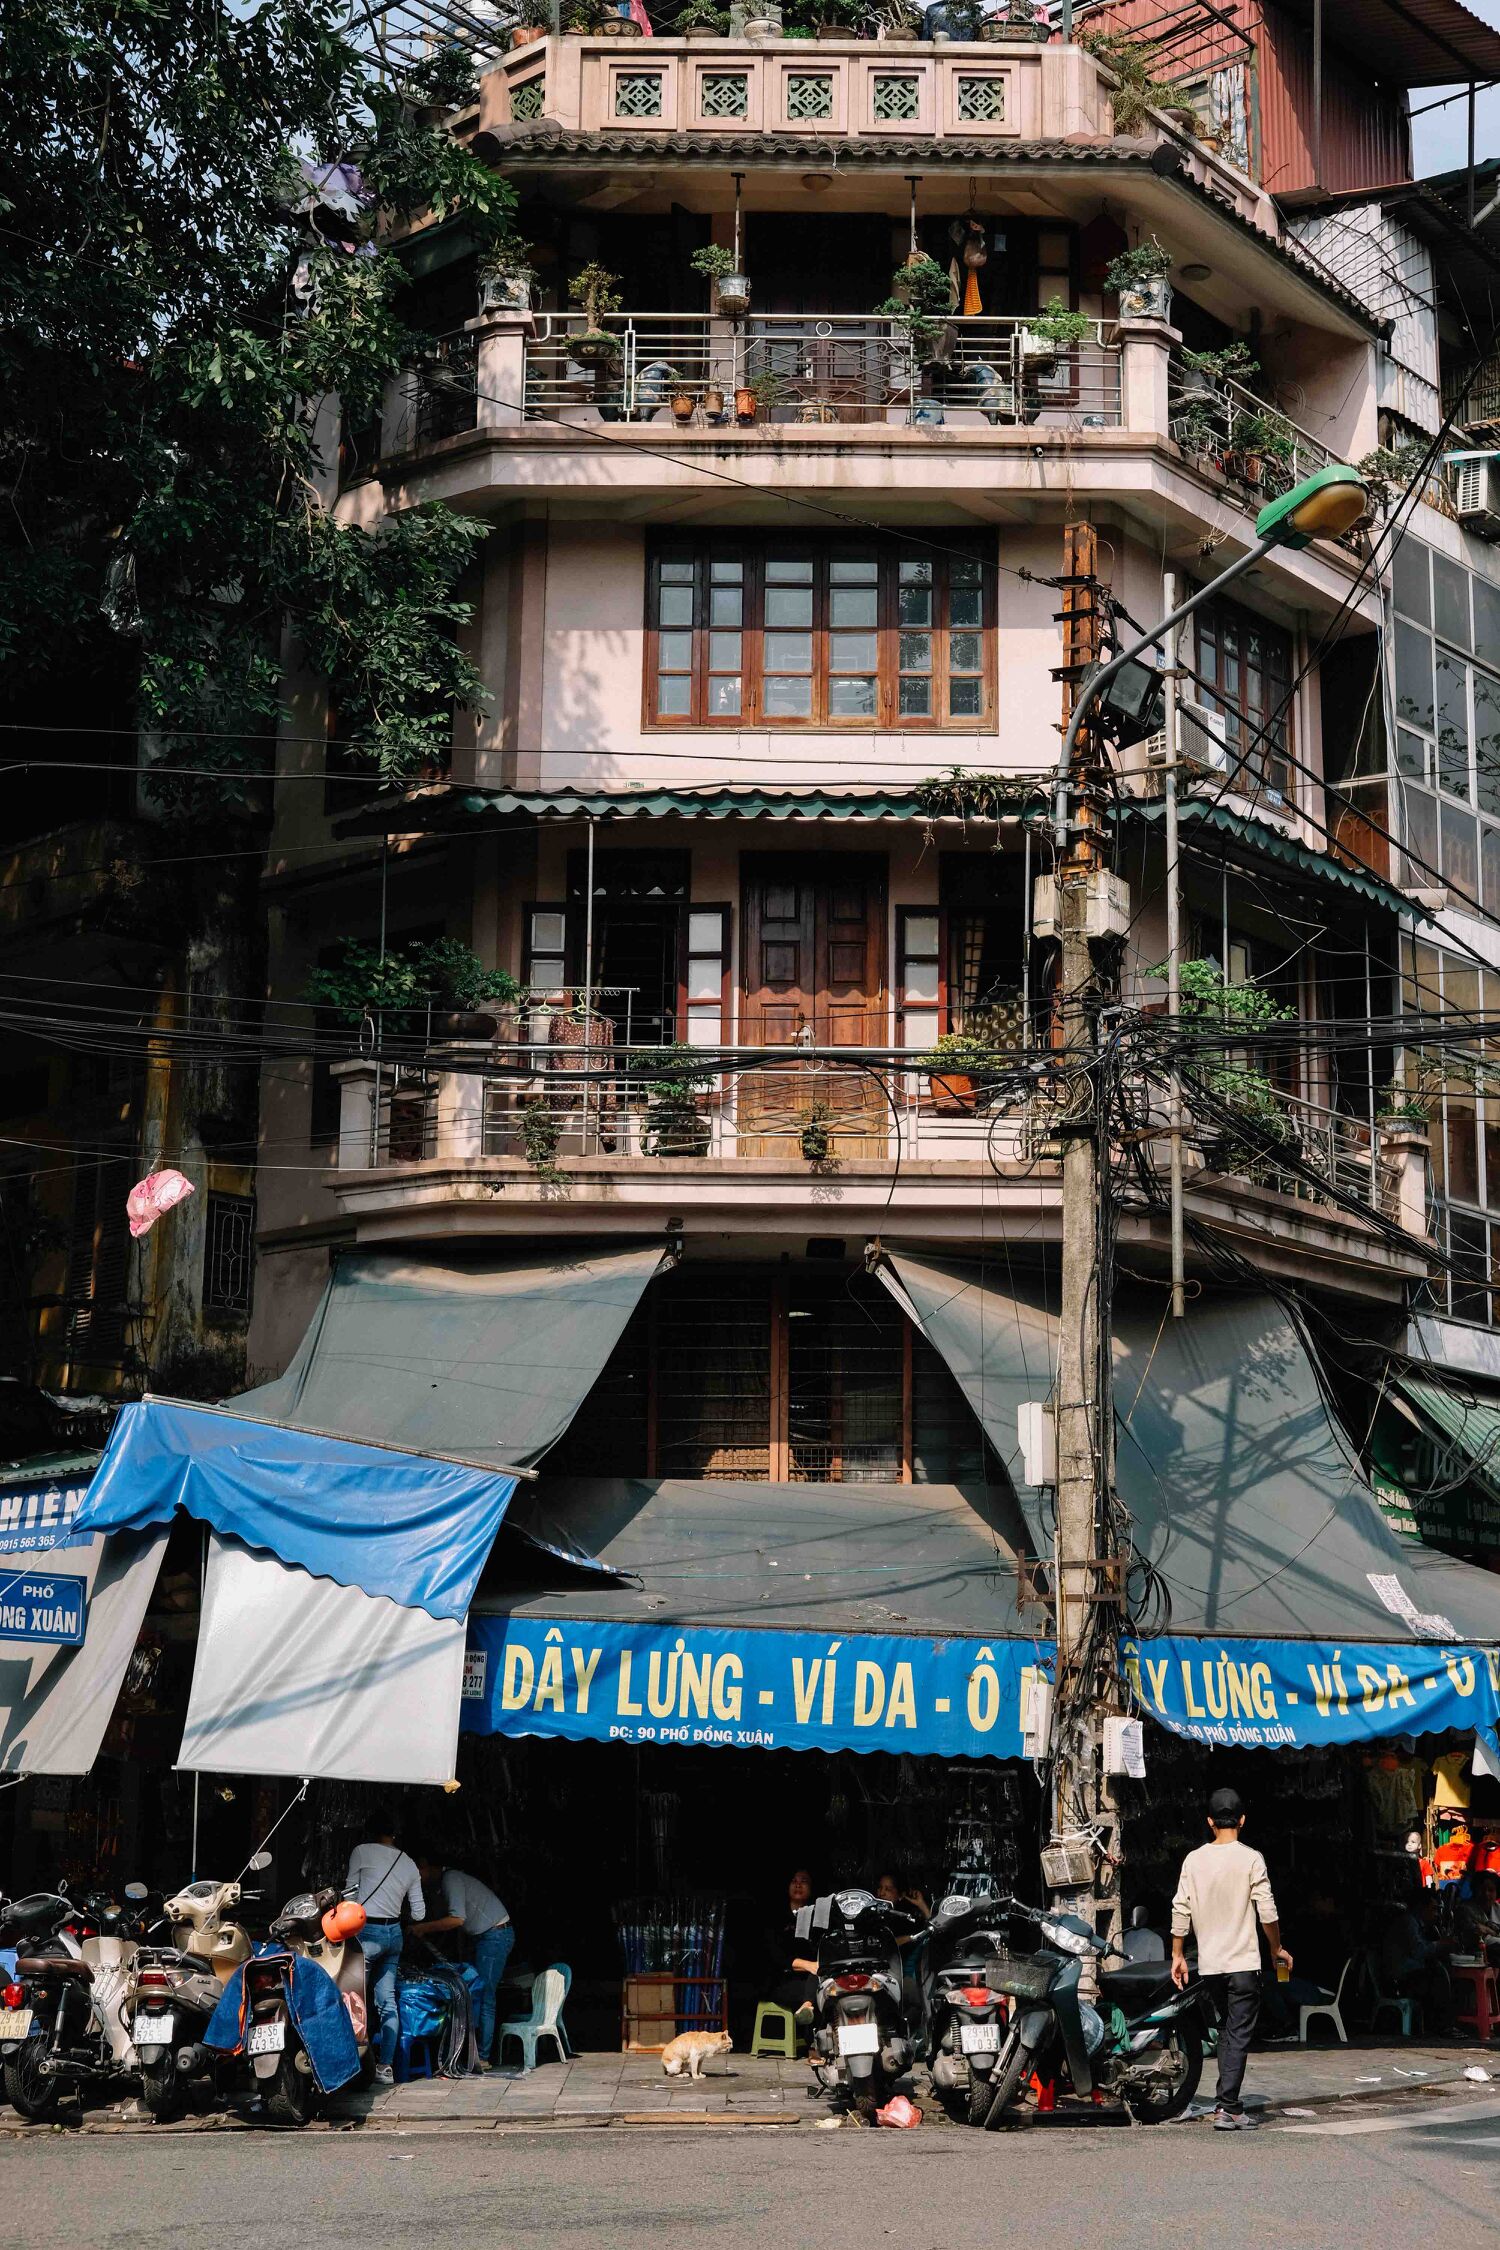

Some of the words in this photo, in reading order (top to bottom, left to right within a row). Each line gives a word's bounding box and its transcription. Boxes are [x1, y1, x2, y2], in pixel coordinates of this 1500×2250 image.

[38, 1534, 56, 1547] 365
[23, 1583, 55, 1599] PHỐ
[0, 1600, 26, 1630] NG
[31, 1606, 77, 1634] XUÂN
[469, 1675, 483, 1688] 277
[501, 1628, 603, 1714] DÂY
[616, 1638, 744, 1722] LƯNG
[791, 1641, 842, 1725] VÍ
[853, 1660, 918, 1729] DA
[967, 1646, 1000, 1733] Ô
[1123, 1641, 1169, 1715] ÂY
[1181, 1649, 1279, 1720] LƯNG
[1306, 1650, 1350, 1718] VÍ
[1356, 1664, 1417, 1713] DA
[609, 1725, 633, 1739] ĐC:
[637, 1726, 656, 1739] 90
[660, 1724, 691, 1741] PHỐ
[736, 1729, 774, 1745] XUÂN
[1188, 1725, 1204, 1739] 90
[1203, 1720, 1228, 1742] PHỐ
[1228, 1720, 1263, 1743] ĐỒNG
[1262, 1722, 1297, 1743] XUÂN
[252, 2024, 278, 2040] 29-S6
